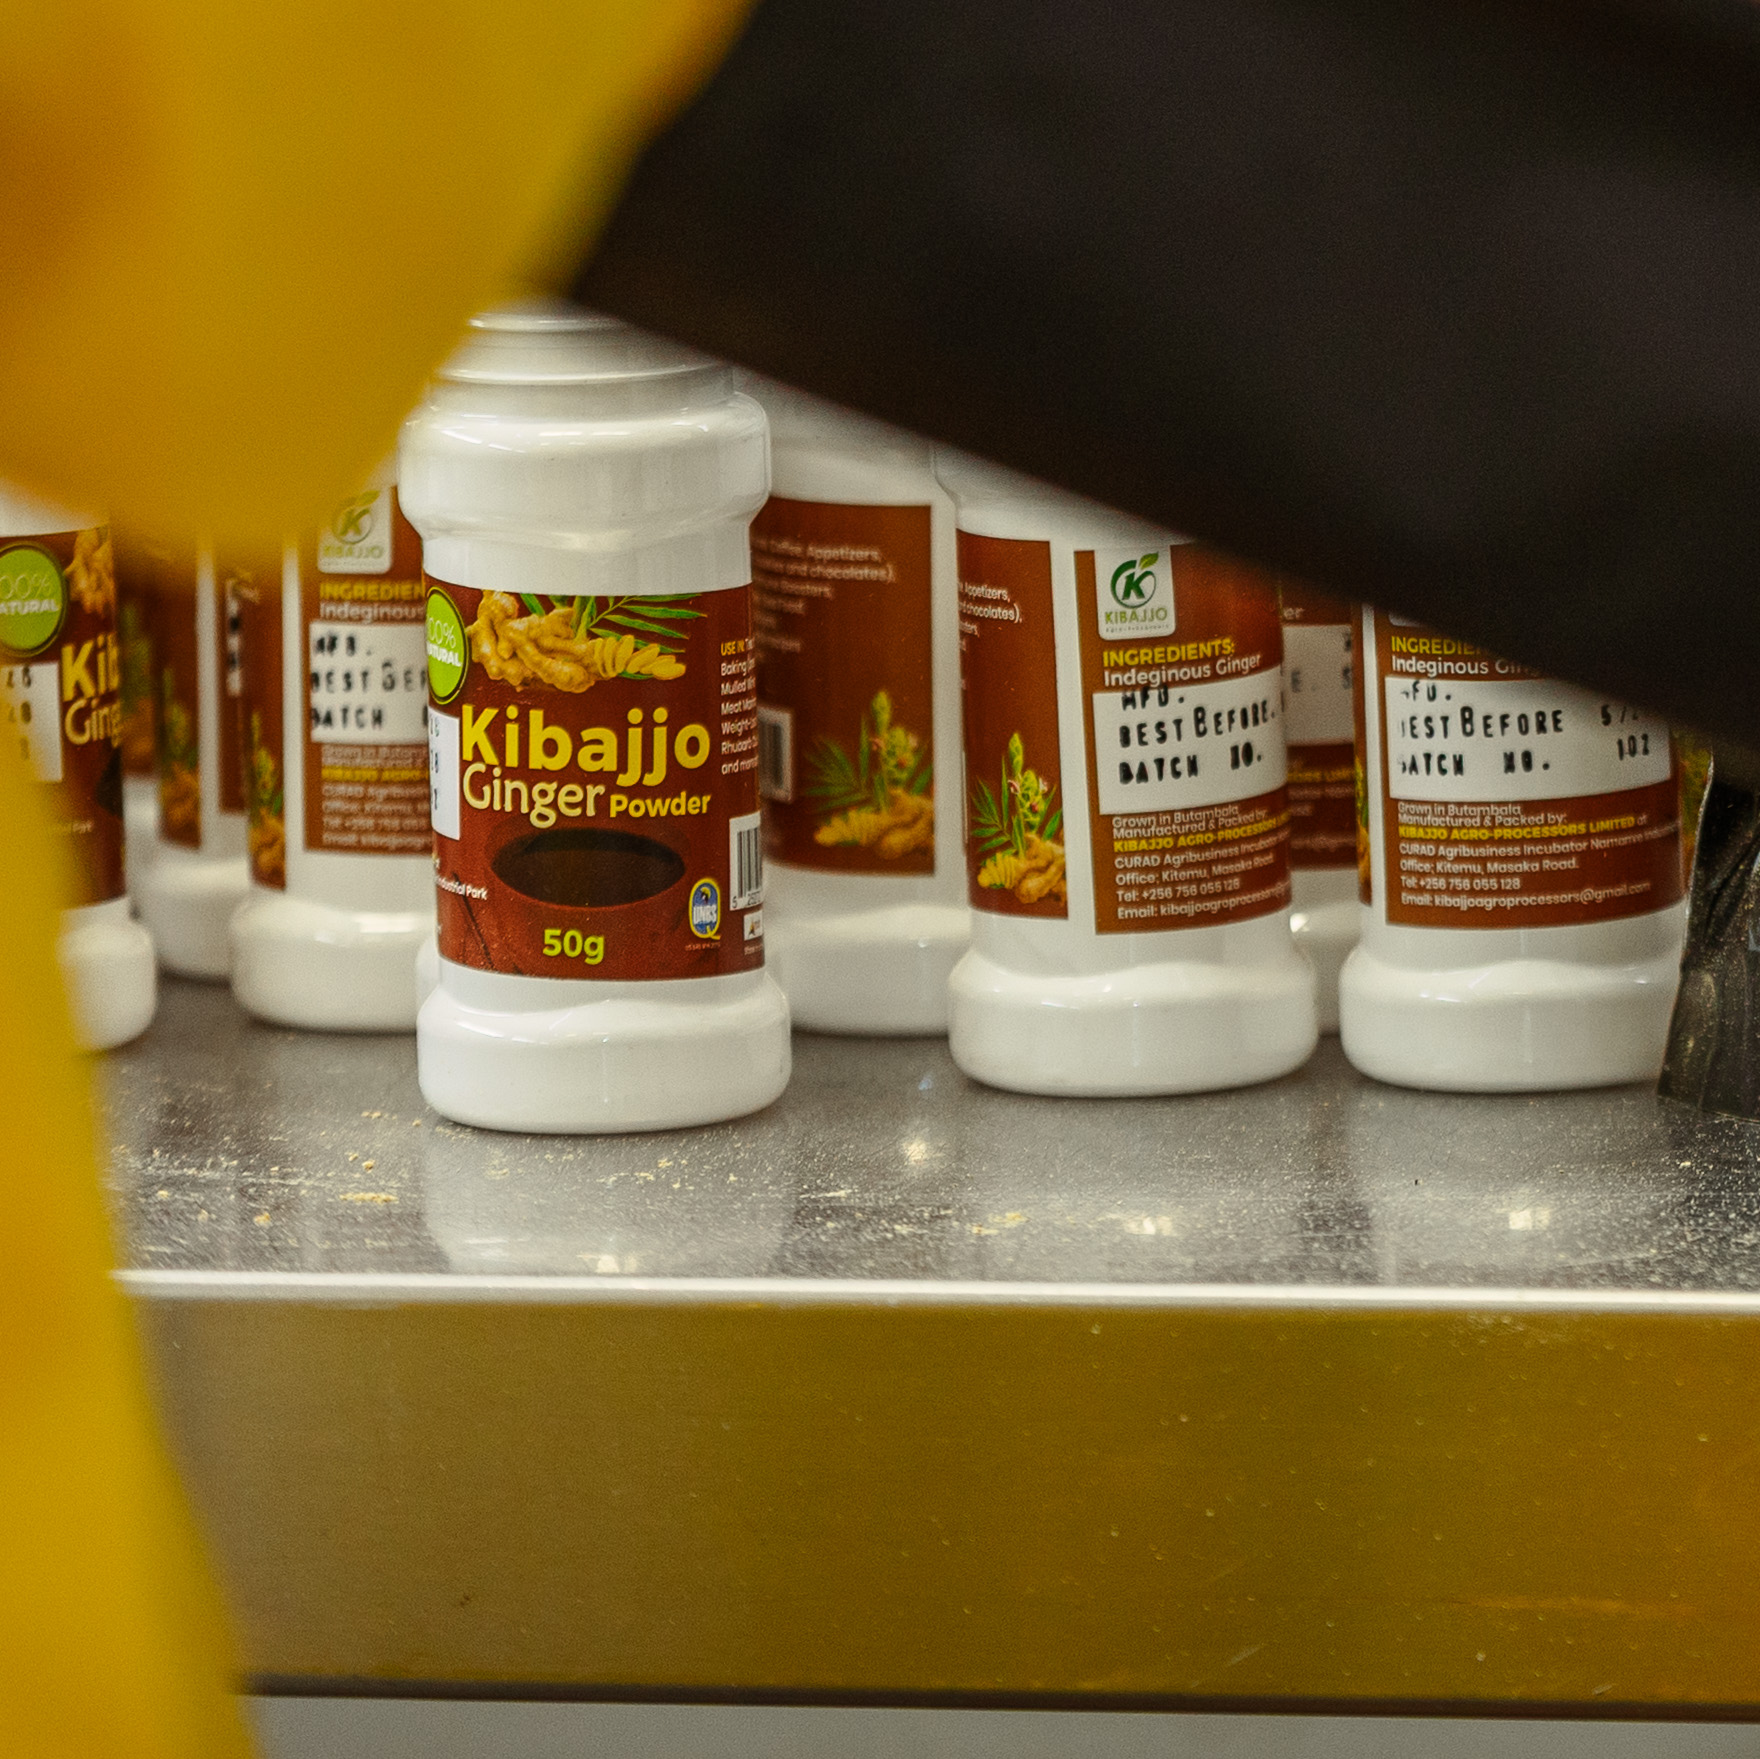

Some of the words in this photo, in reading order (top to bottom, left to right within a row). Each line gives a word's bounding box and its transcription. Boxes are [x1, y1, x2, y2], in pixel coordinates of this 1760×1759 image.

[1105, 607, 1168, 625] KIBAJJO
[1103, 637, 1235, 668] INGREDIENTS:
[1104, 666, 1211, 687] Indeginous
[1216, 654, 1262, 677] Ginger
[1391, 655, 1489, 677] Indeginous
[1119, 718, 1184, 748] BEST
[461, 704, 710, 787] Kibajjo
[1119, 754, 1199, 785] BATCH
[462, 762, 606, 828] Ginger
[609, 790, 712, 820] Powder
[1113, 816, 1157, 829] Grown
[1159, 814, 1171, 826] in
[1173, 805, 1239, 824] Butambala
[1398, 802, 1432, 816] Grown
[1434, 803, 1446, 815] in
[1448, 804, 1521, 817] Butambala
[1398, 813, 1480, 827] Manufactured
[1483, 816, 1492, 827] &
[1495, 813, 1545, 827] Packed
[1113, 822, 1206, 840] Manufactured
[1450, 822, 1587, 840] AGRO-PROCESSORS
[1589, 815, 1636, 834] LIMITED
[1113, 837, 1174, 852] KIBAJJO
[1399, 842, 1436, 857] CURAD
[1438, 844, 1521, 861] Agribusiness
[1523, 841, 1589, 856] Incubator
[1114, 855, 1161, 869] CURAD
[1163, 846, 1239, 868] Agribusiness
[1436, 861, 1485, 876] Kitemu,
[1487, 861, 1540, 875] Masaka
[1501, 877, 1521, 891] 128
[543, 927, 605, 965] 50g
